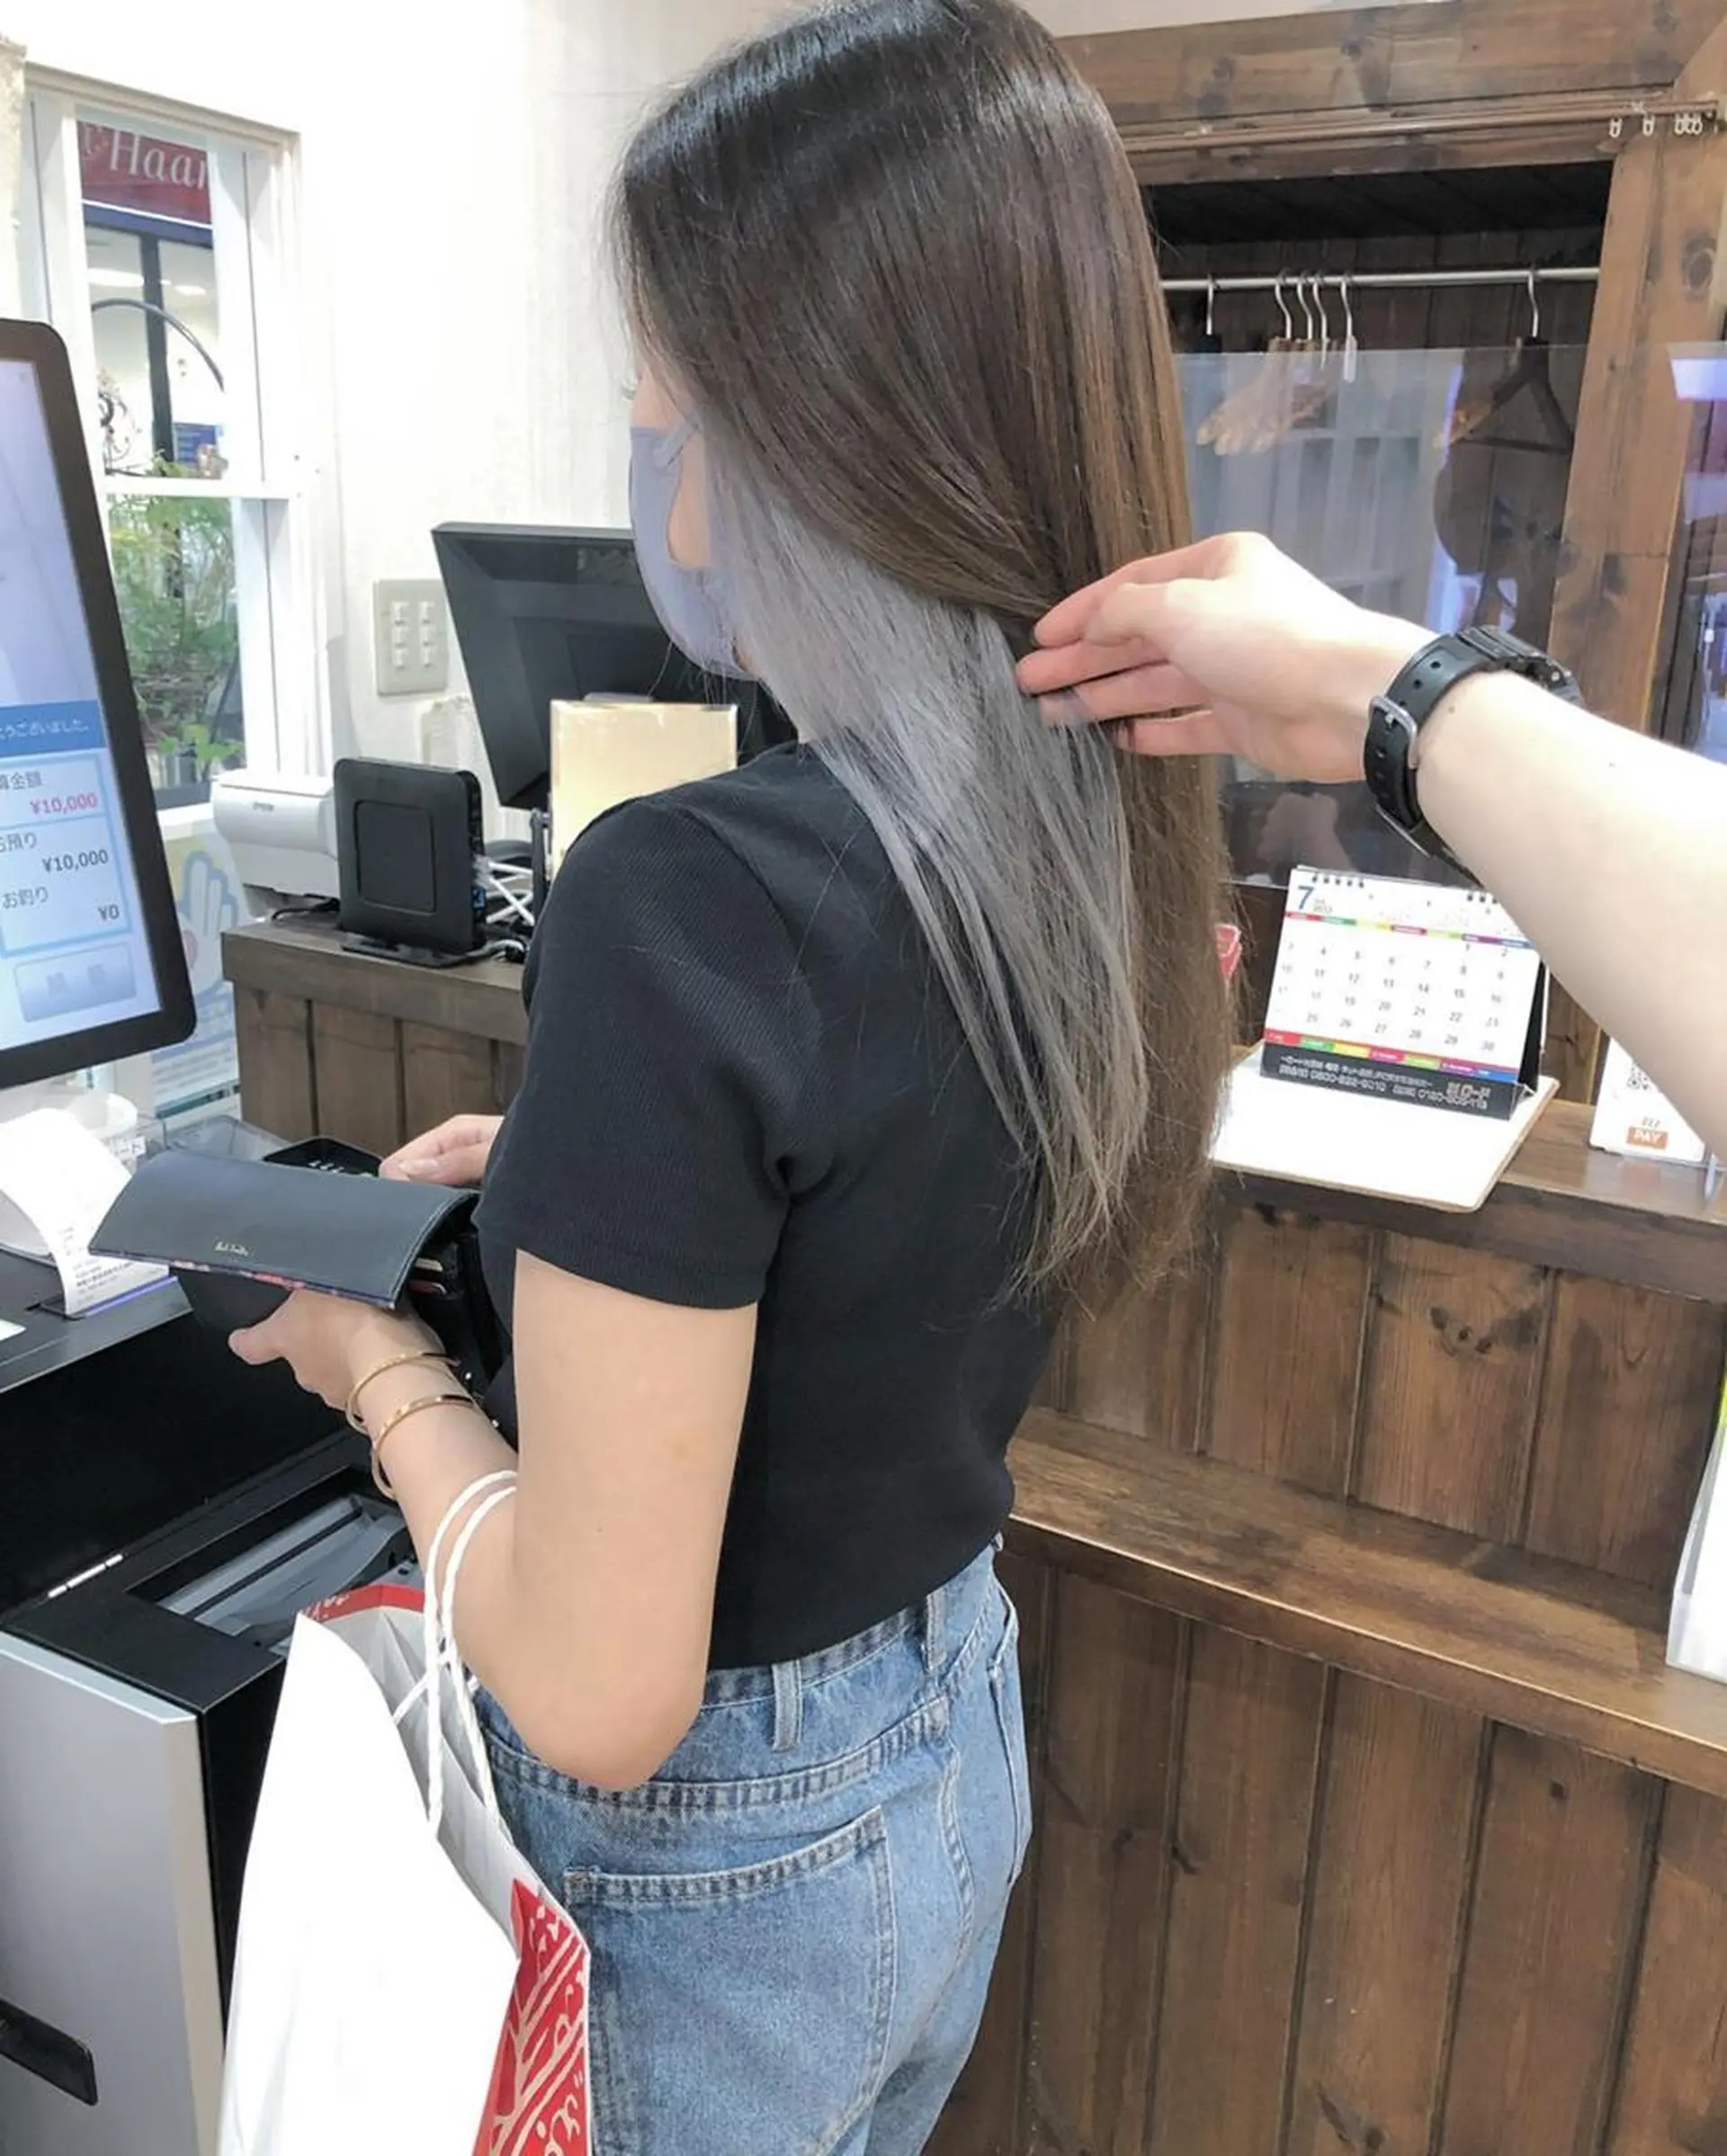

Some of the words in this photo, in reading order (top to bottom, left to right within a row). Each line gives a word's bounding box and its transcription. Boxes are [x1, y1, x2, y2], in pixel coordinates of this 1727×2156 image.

[30, 792, 97, 815] ¥10,000
[42, 849, 109, 872] ¥10,000
[1298, 885, 1315, 910] 7
[97, 904, 120, 921] ¥0
